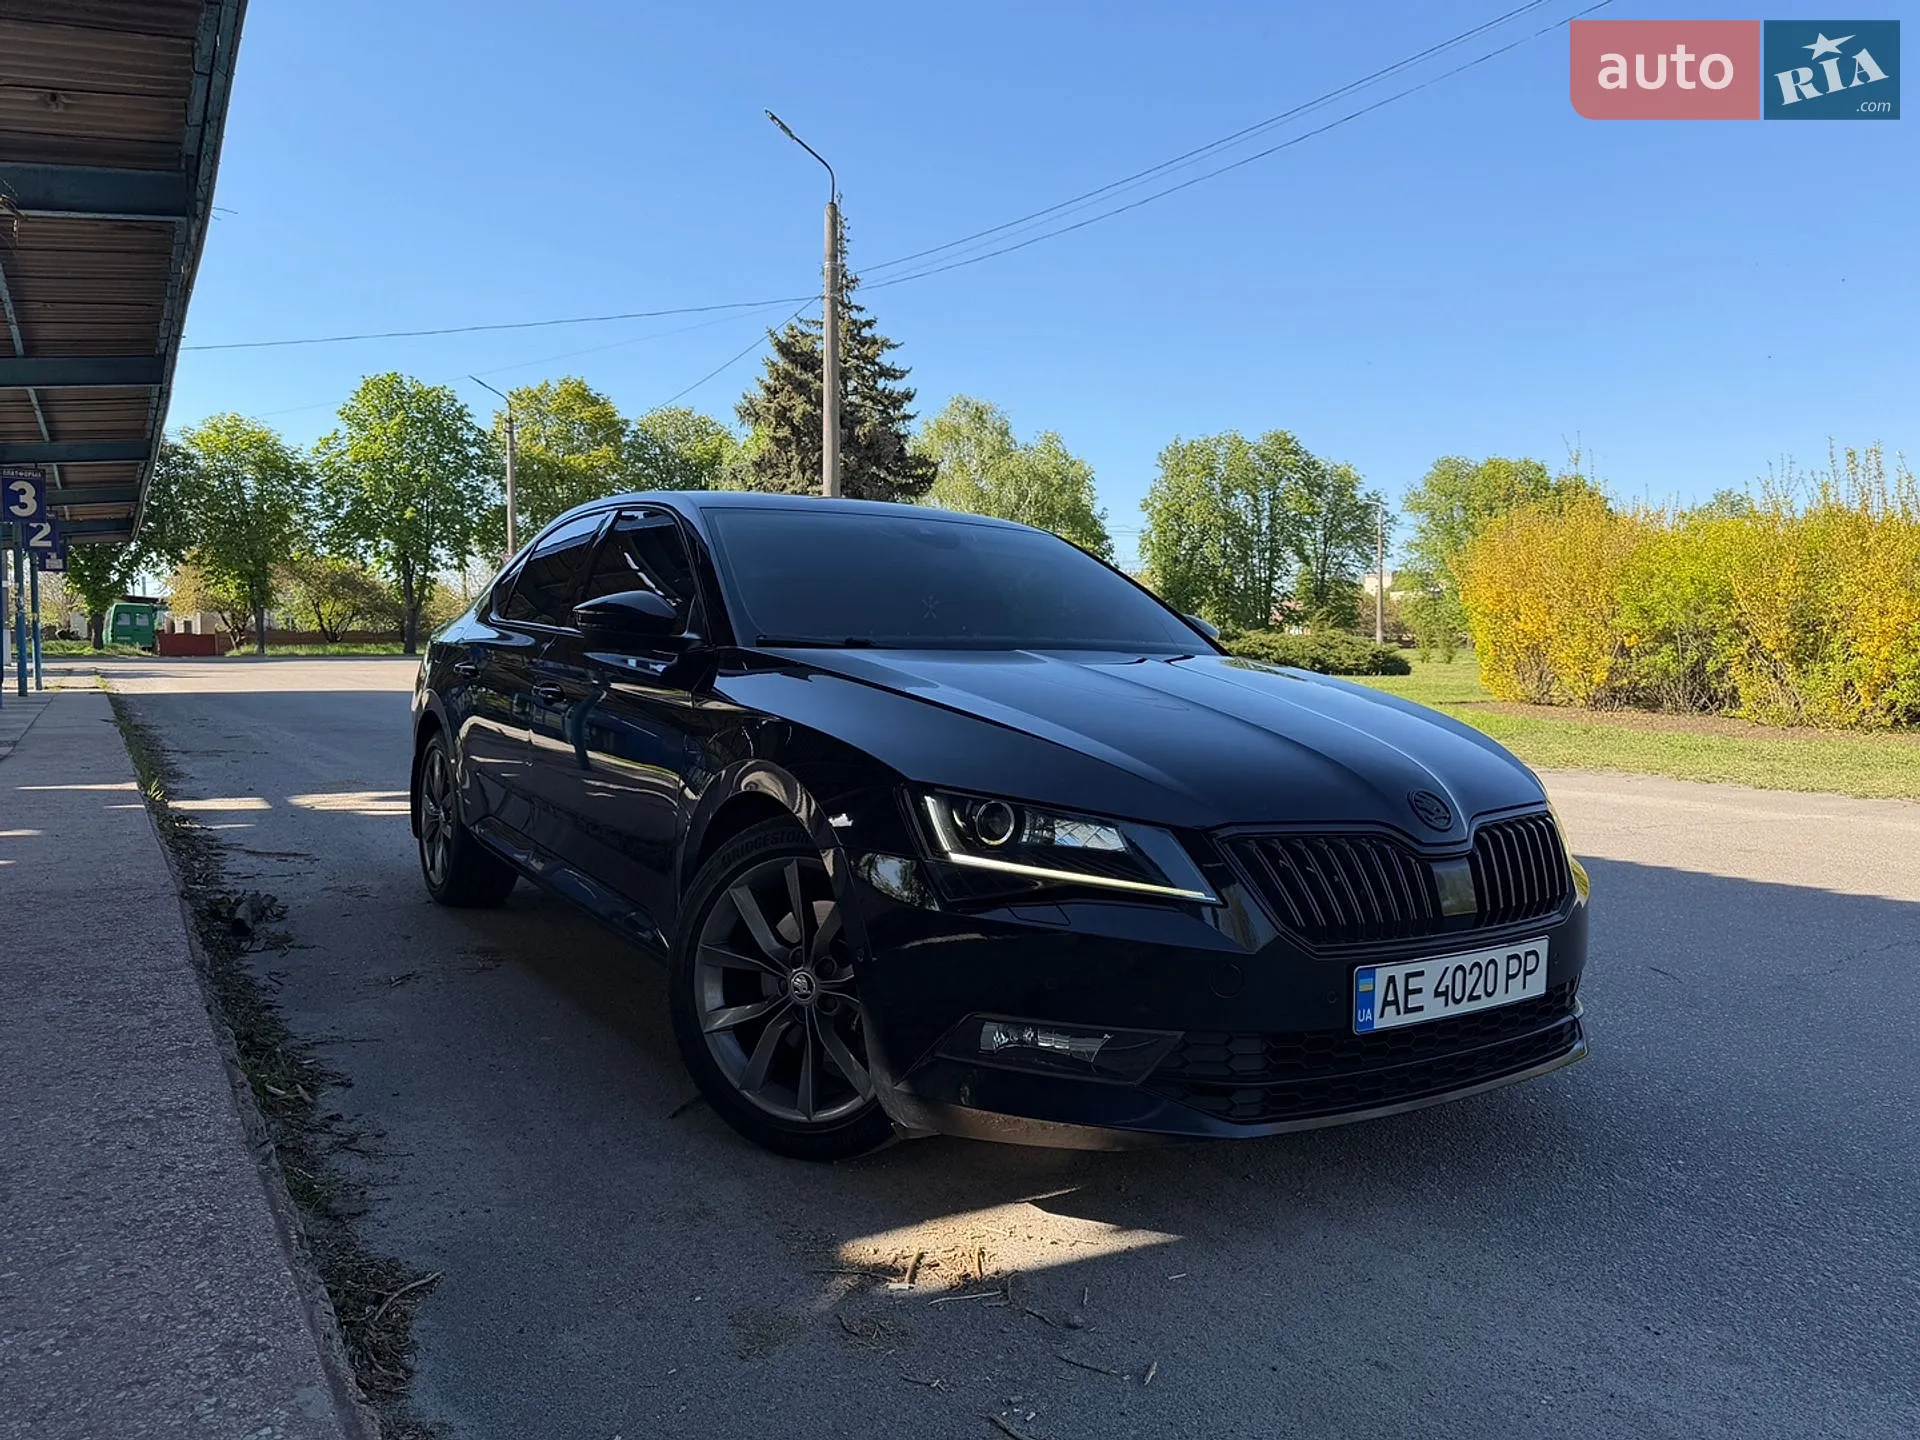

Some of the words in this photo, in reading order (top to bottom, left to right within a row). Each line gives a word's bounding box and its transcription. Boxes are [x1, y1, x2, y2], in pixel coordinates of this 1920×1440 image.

[9, 480, 37, 517] 3
[29, 522, 52, 547] 2
[1379, 970, 1425, 1019] AE
[1433, 957, 1498, 1007] 4020
[1504, 949, 1540, 994] PP
[1357, 1009, 1373, 1023] UA
